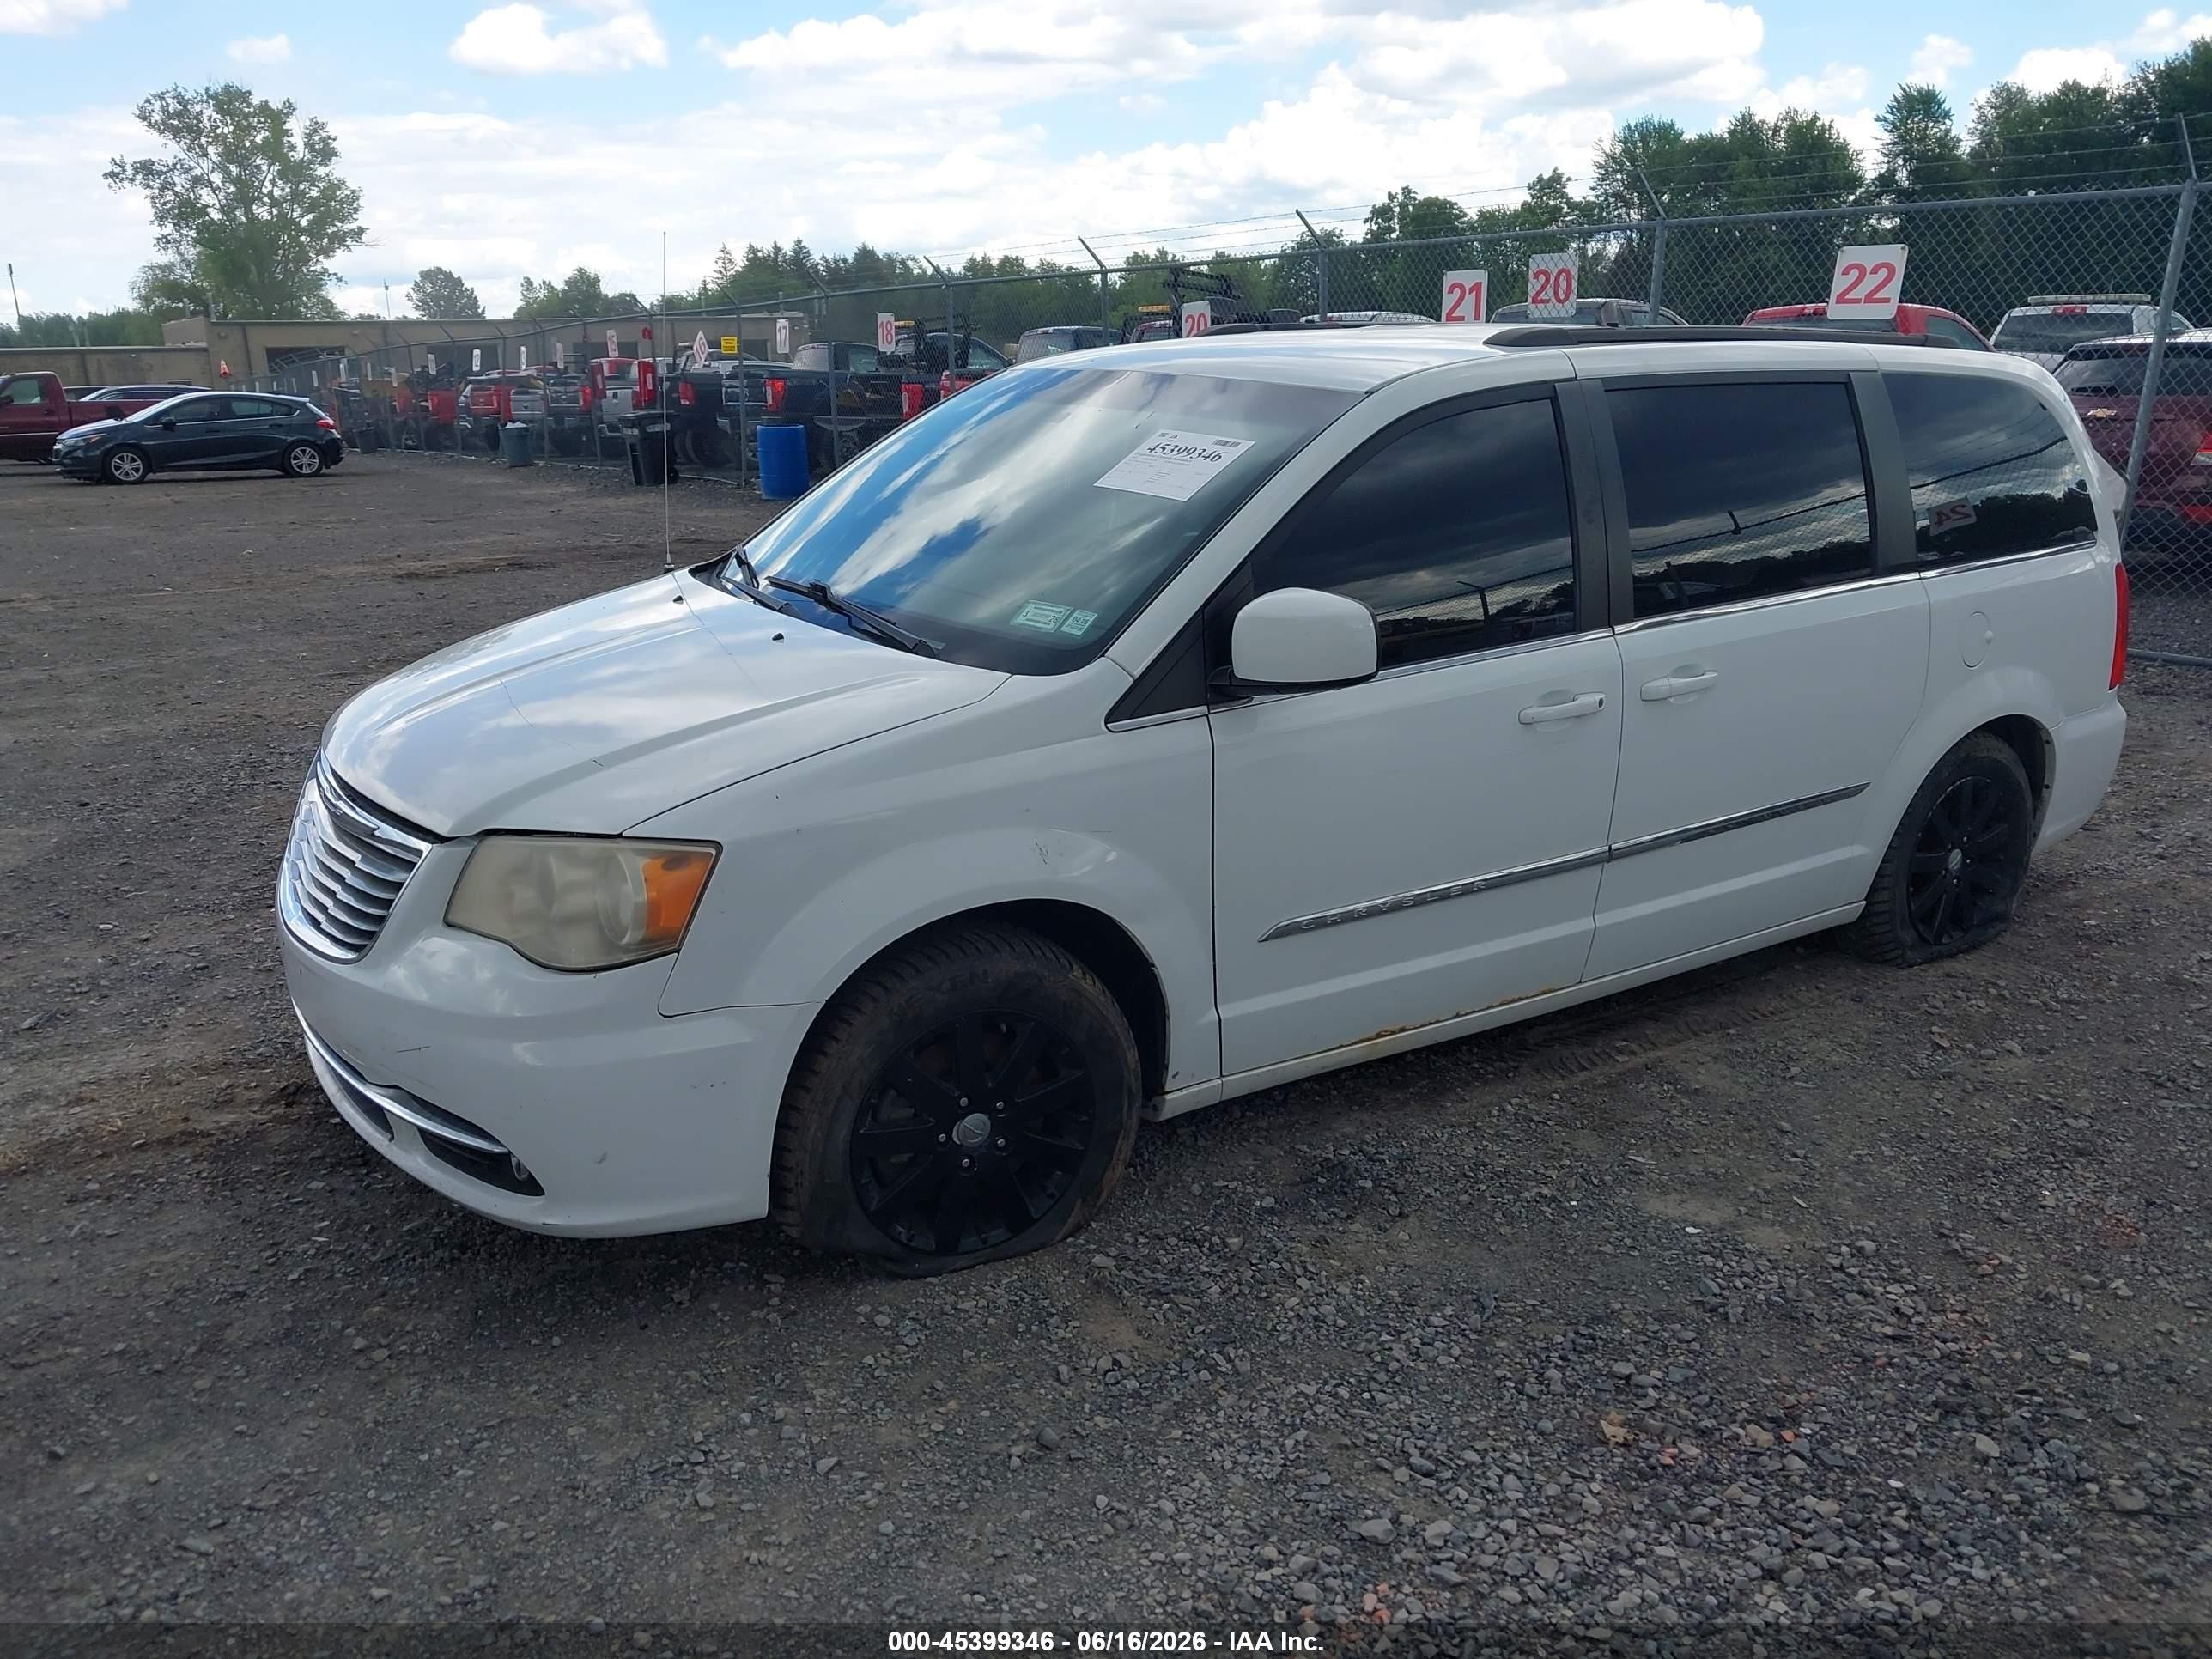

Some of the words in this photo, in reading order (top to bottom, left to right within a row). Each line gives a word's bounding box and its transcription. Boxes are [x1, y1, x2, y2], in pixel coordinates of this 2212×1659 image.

[1531, 267, 1573, 304] 20
[1834, 261, 1897, 305] 22
[1445, 281, 1483, 322] 21
[777, 325, 787, 348] 17
[878, 319, 894, 345] 18
[1184, 312, 1208, 337] 20
[1146, 441, 1229, 463] 45399346
